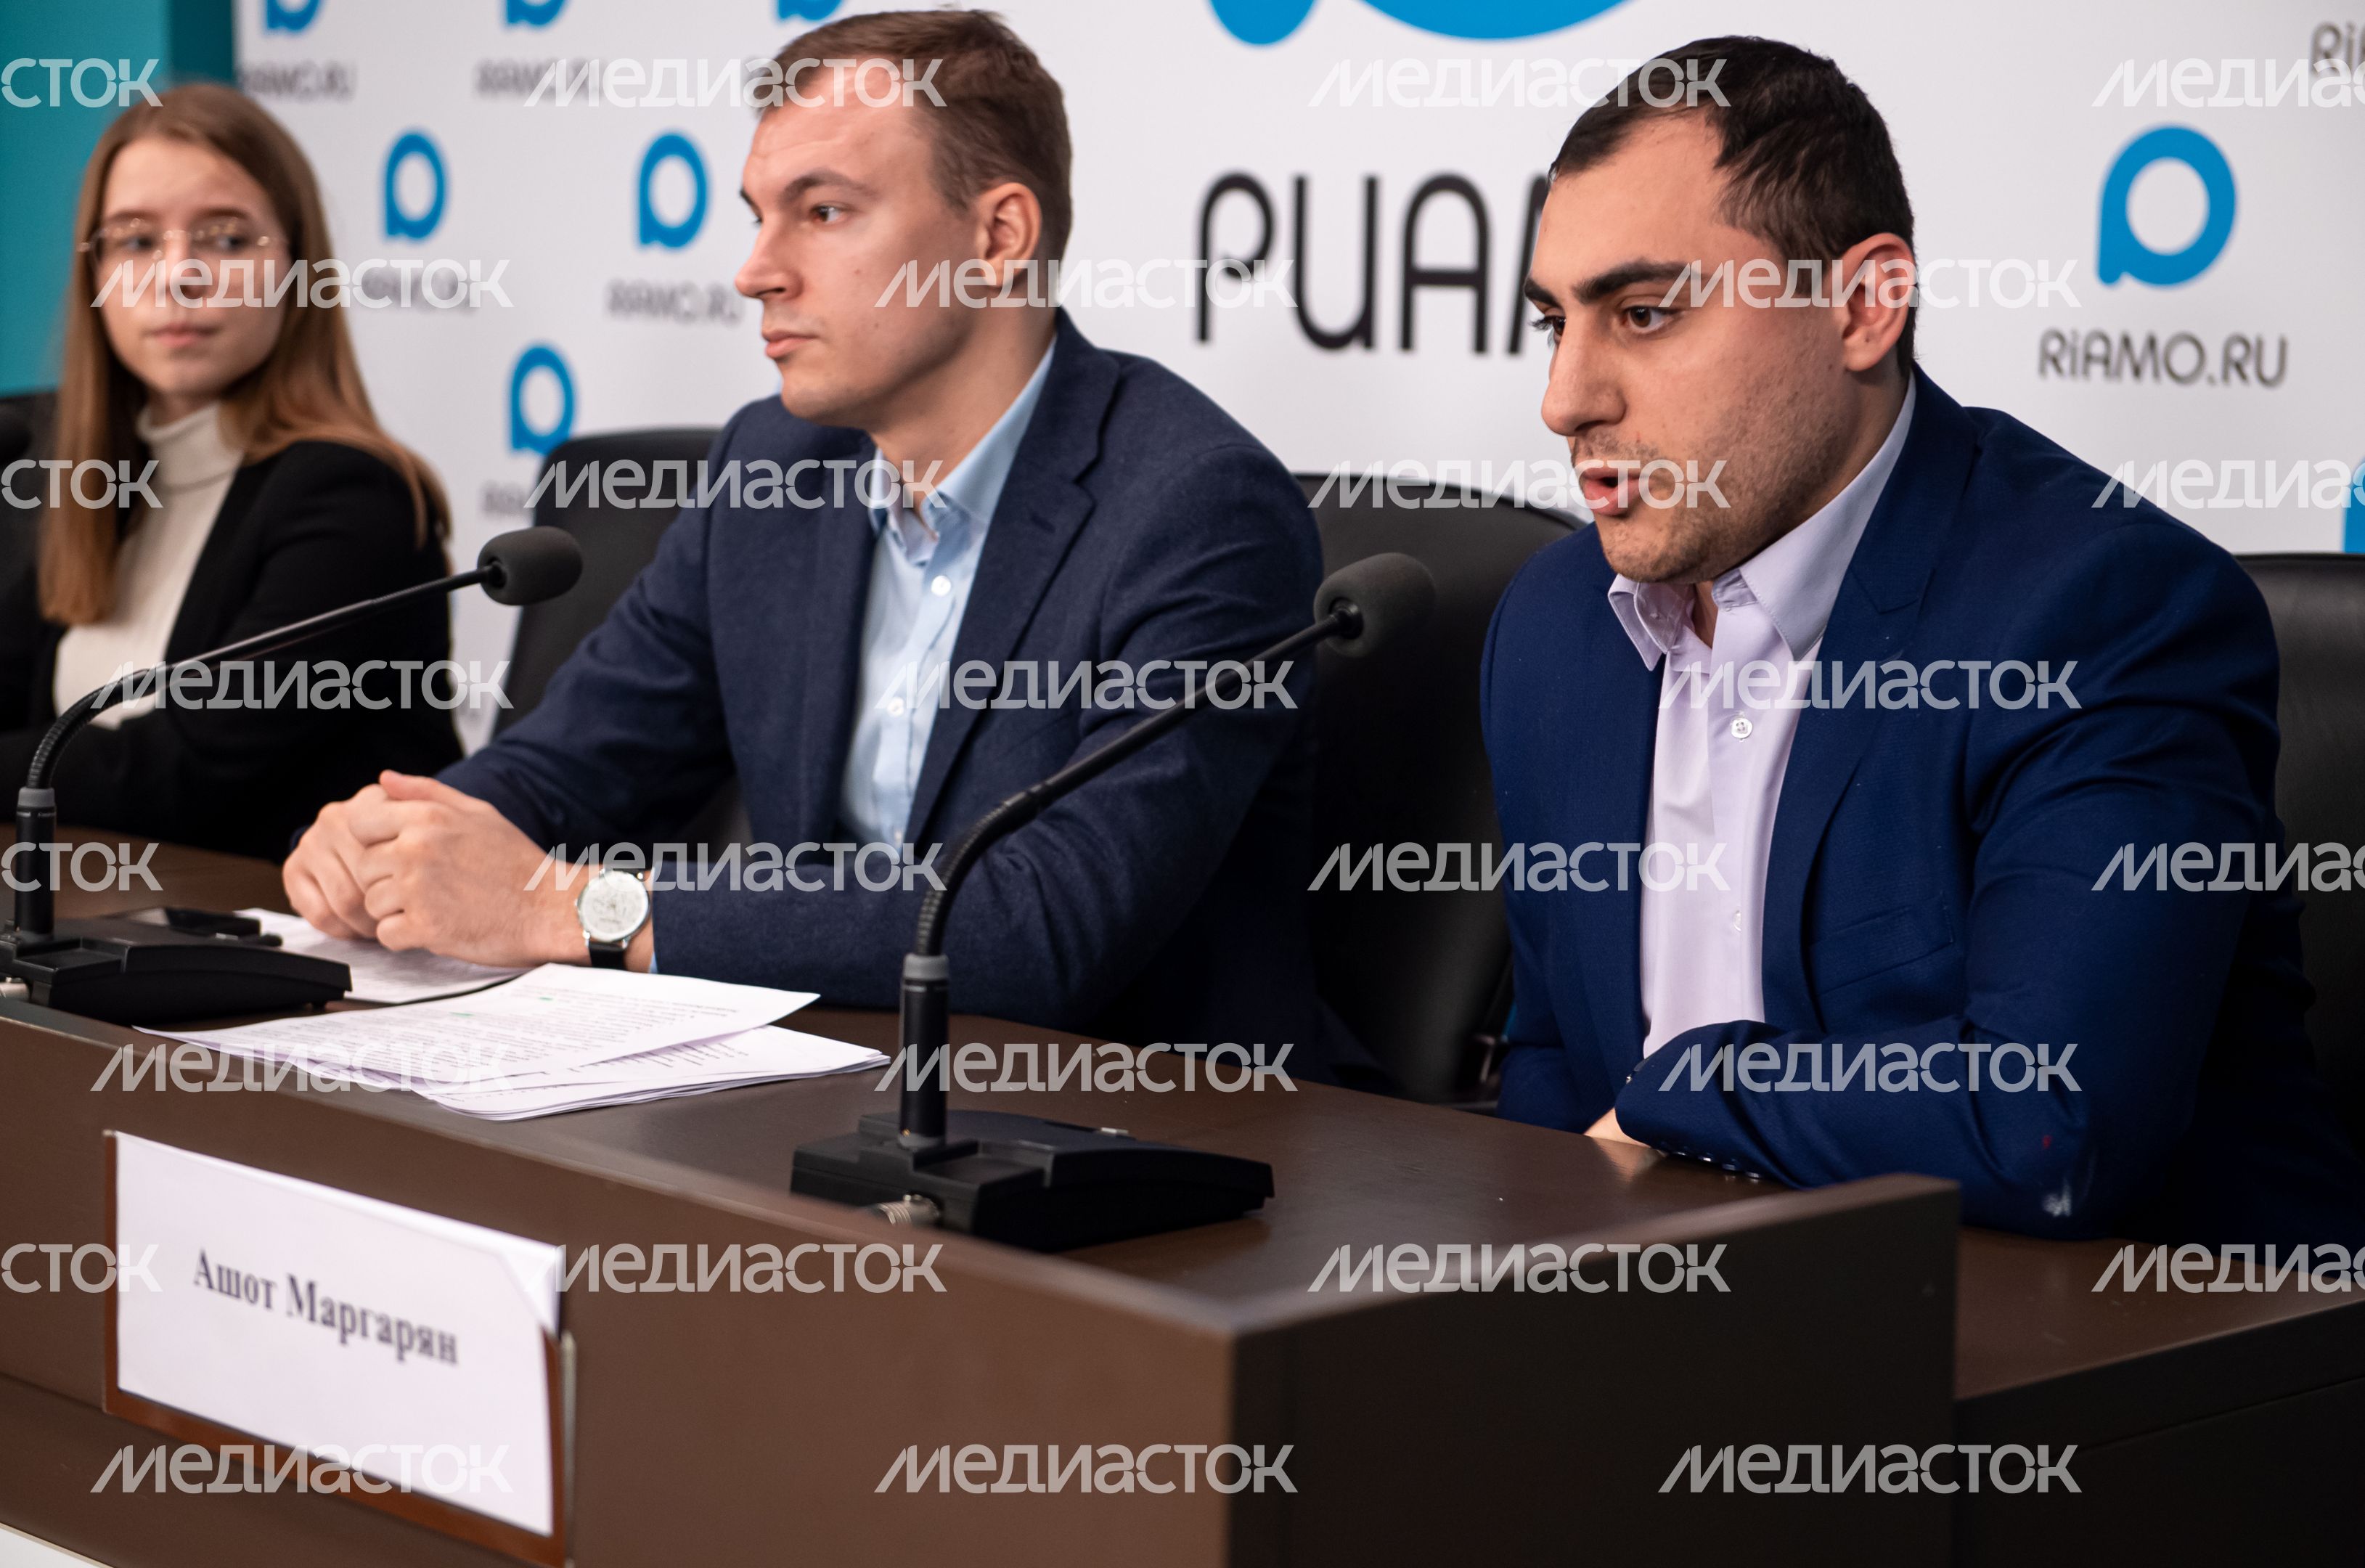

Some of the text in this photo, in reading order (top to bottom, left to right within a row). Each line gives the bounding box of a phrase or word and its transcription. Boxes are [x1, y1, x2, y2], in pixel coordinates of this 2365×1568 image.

[2310, 22, 2365, 77] Ri
[1195, 171, 1551, 354] РИА
[193, 1248, 458, 1363] Ашот Маргарян
